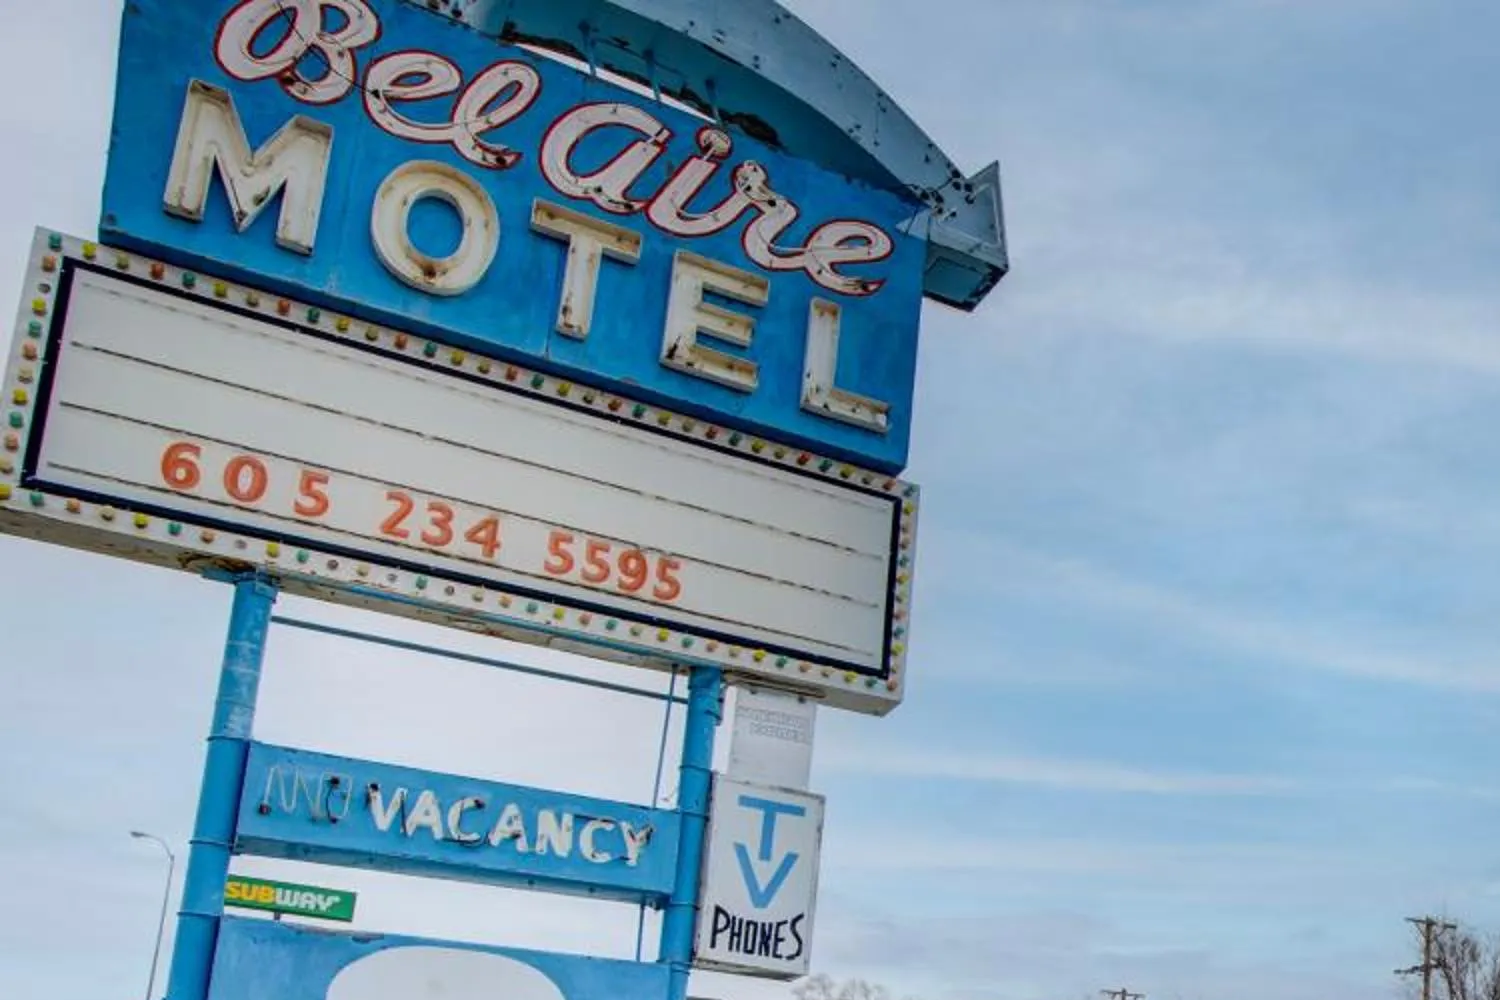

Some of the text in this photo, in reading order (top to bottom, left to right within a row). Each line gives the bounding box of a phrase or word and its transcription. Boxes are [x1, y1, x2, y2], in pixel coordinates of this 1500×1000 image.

[213, 0, 542, 169] Bel
[163, 78, 891, 434] MOTEL
[379, 491, 501, 559] 234
[543, 530, 682, 602] 5595
[367, 783, 655, 867] VACANCY
[225, 881, 340, 913] SUBWAY
[710, 904, 804, 961] PHONES
